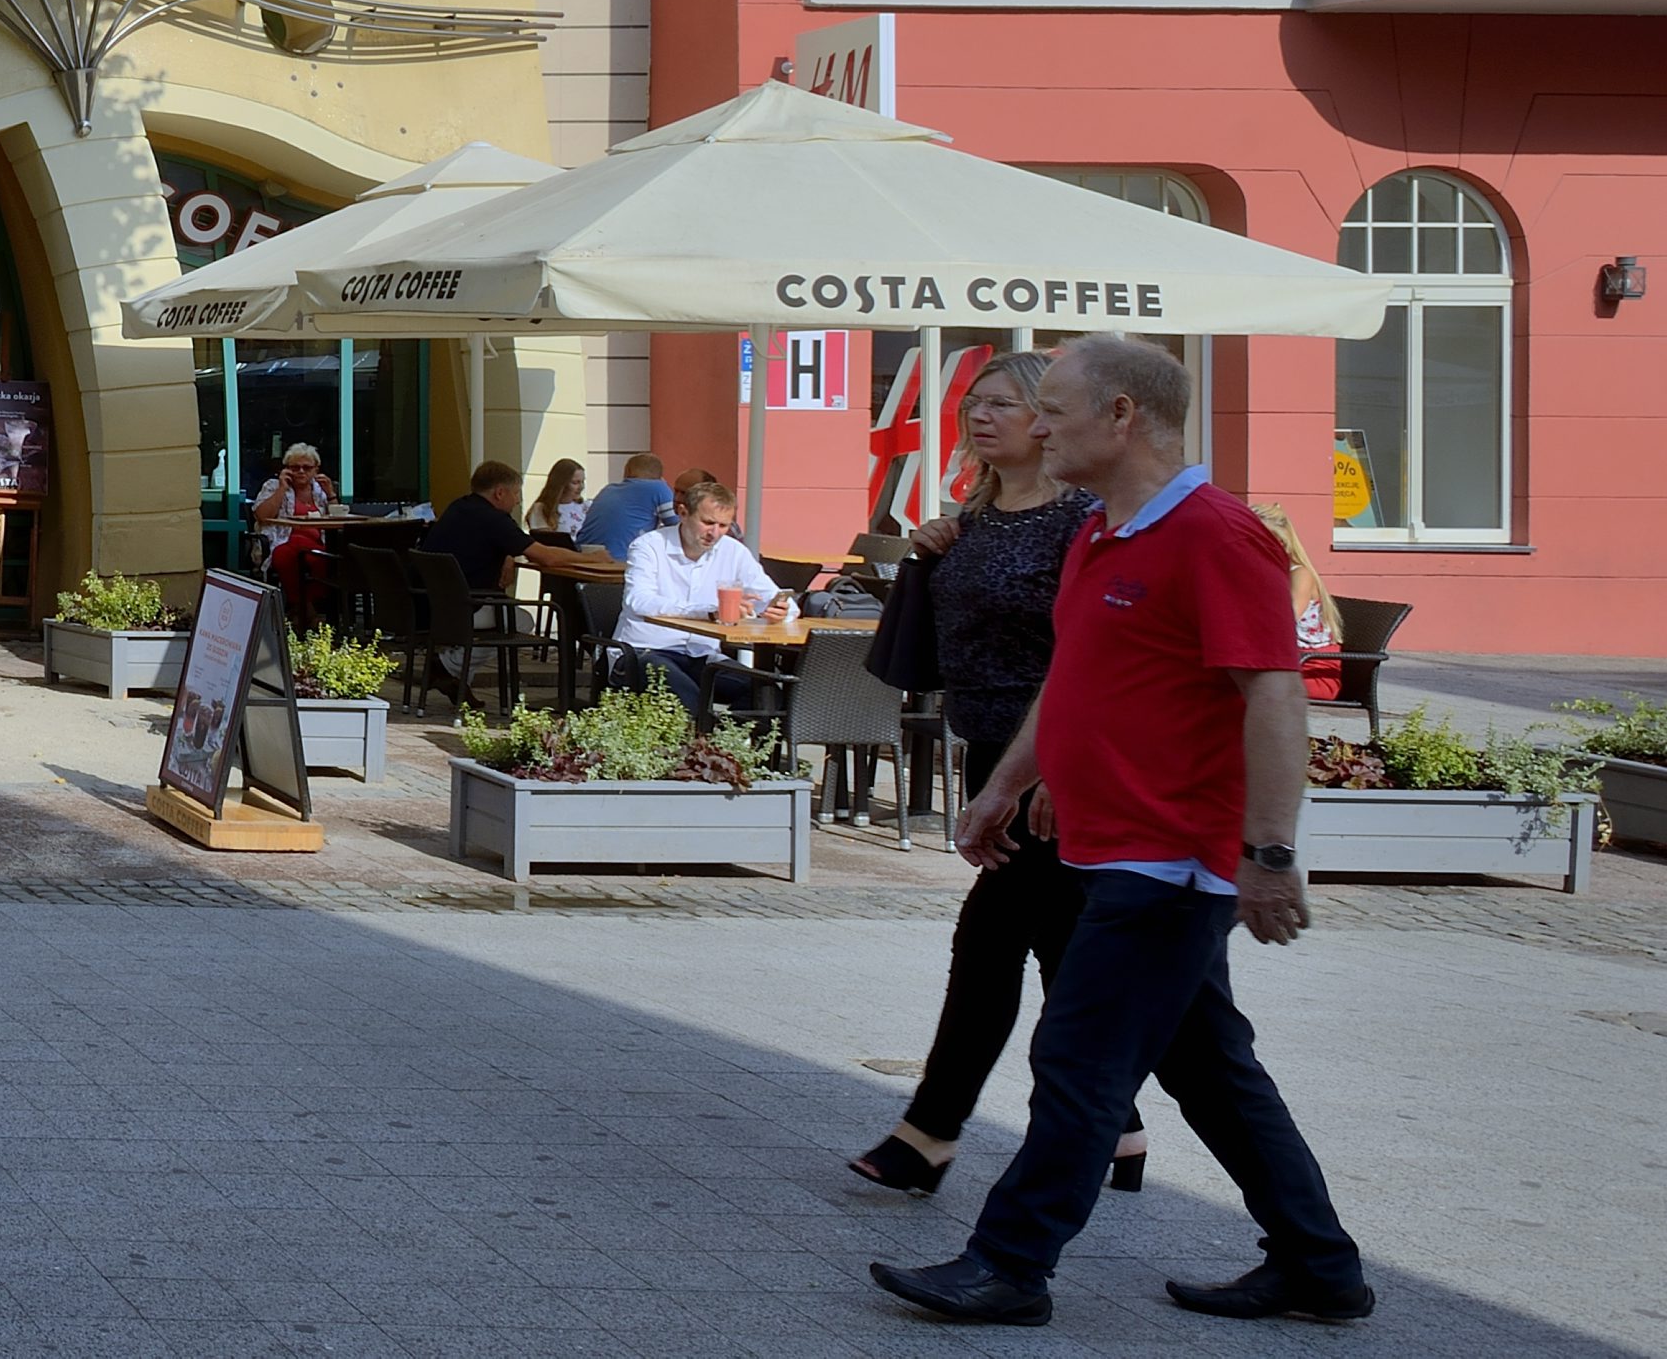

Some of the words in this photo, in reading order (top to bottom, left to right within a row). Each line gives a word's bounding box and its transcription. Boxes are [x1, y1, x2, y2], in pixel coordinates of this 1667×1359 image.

[809, 44, 872, 109] HM
[341, 273, 395, 306] COSTA
[395, 269, 463, 300] COFFEE
[776, 274, 946, 314] COSTA
[967, 278, 1163, 318] COFFEE
[156, 305, 196, 330] COSTA
[198, 301, 247, 325] COFFEE
[791, 339, 821, 399] H
[13, 391, 41, 404] okazja
